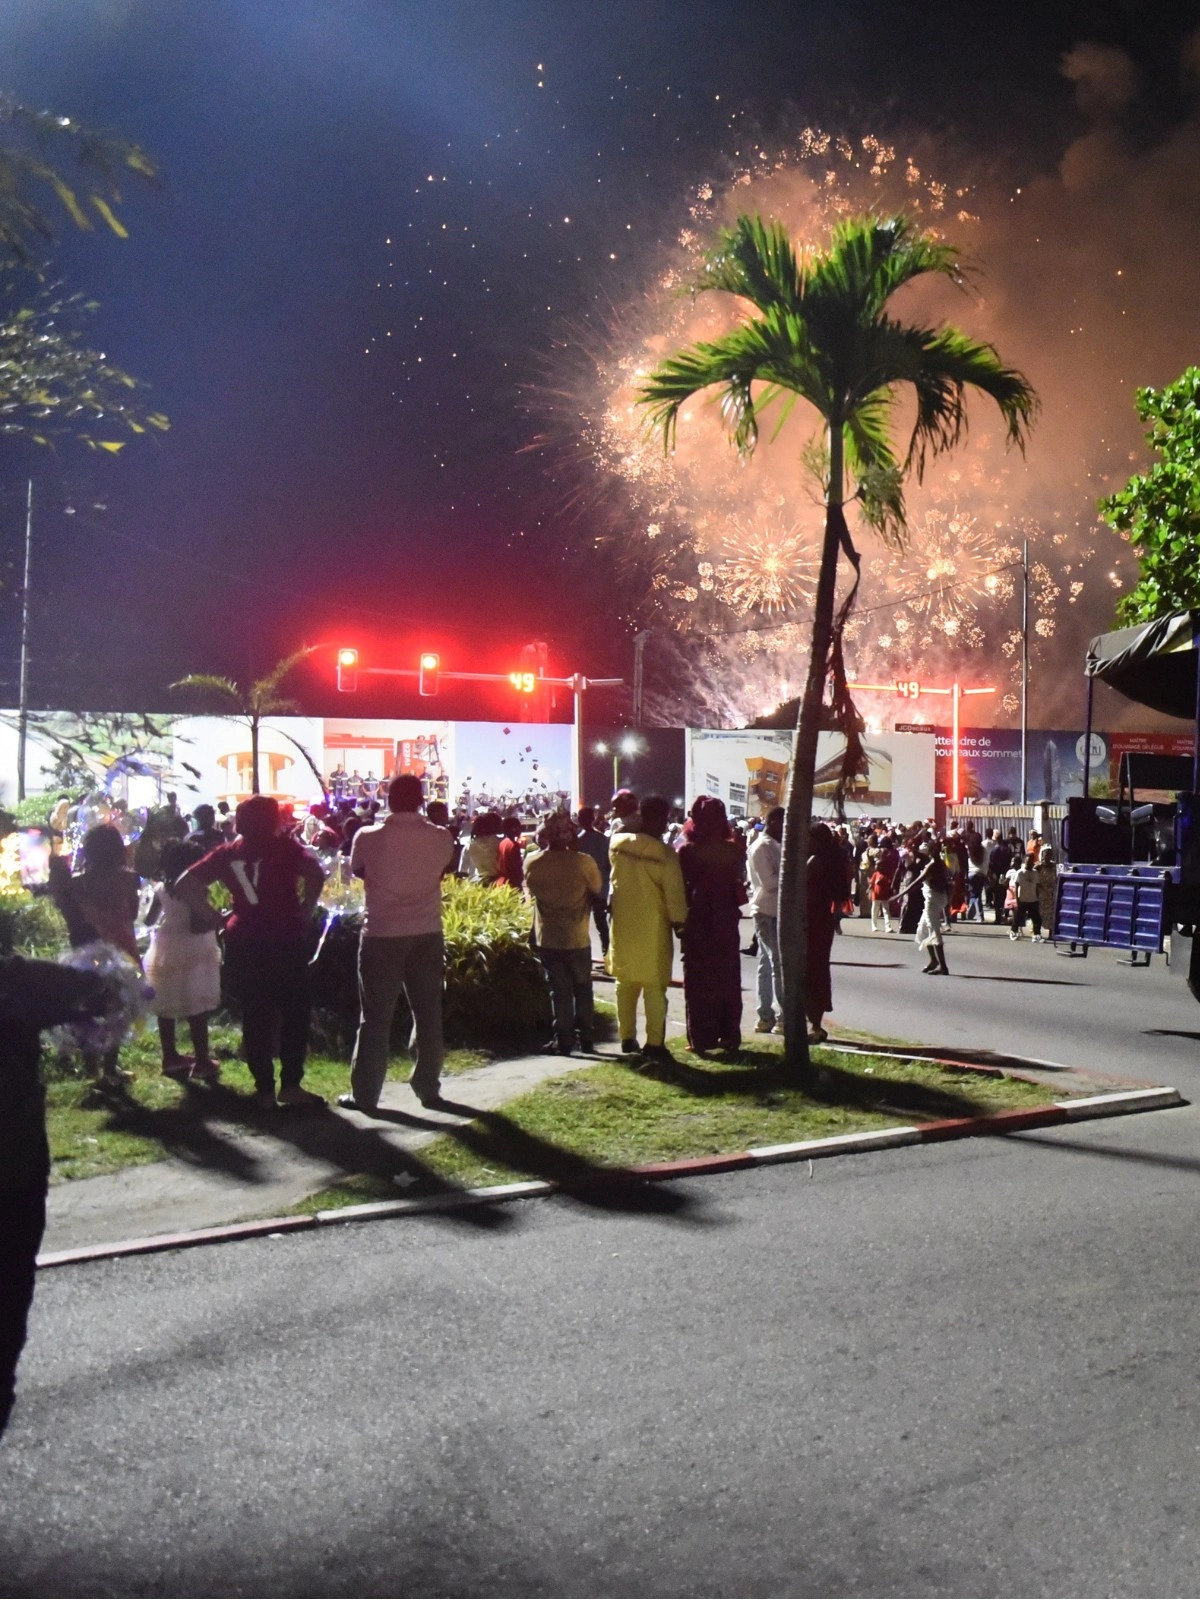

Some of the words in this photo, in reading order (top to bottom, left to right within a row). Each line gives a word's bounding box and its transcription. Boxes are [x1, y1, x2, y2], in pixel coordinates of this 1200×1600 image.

[510, 672, 535, 693] 49
[898, 681, 919, 699] 49
[934, 735, 977, 747] atteidre
[978, 736, 992, 747] de
[402, 742, 411, 767] IVECO
[981, 748, 1025, 758] sommet
